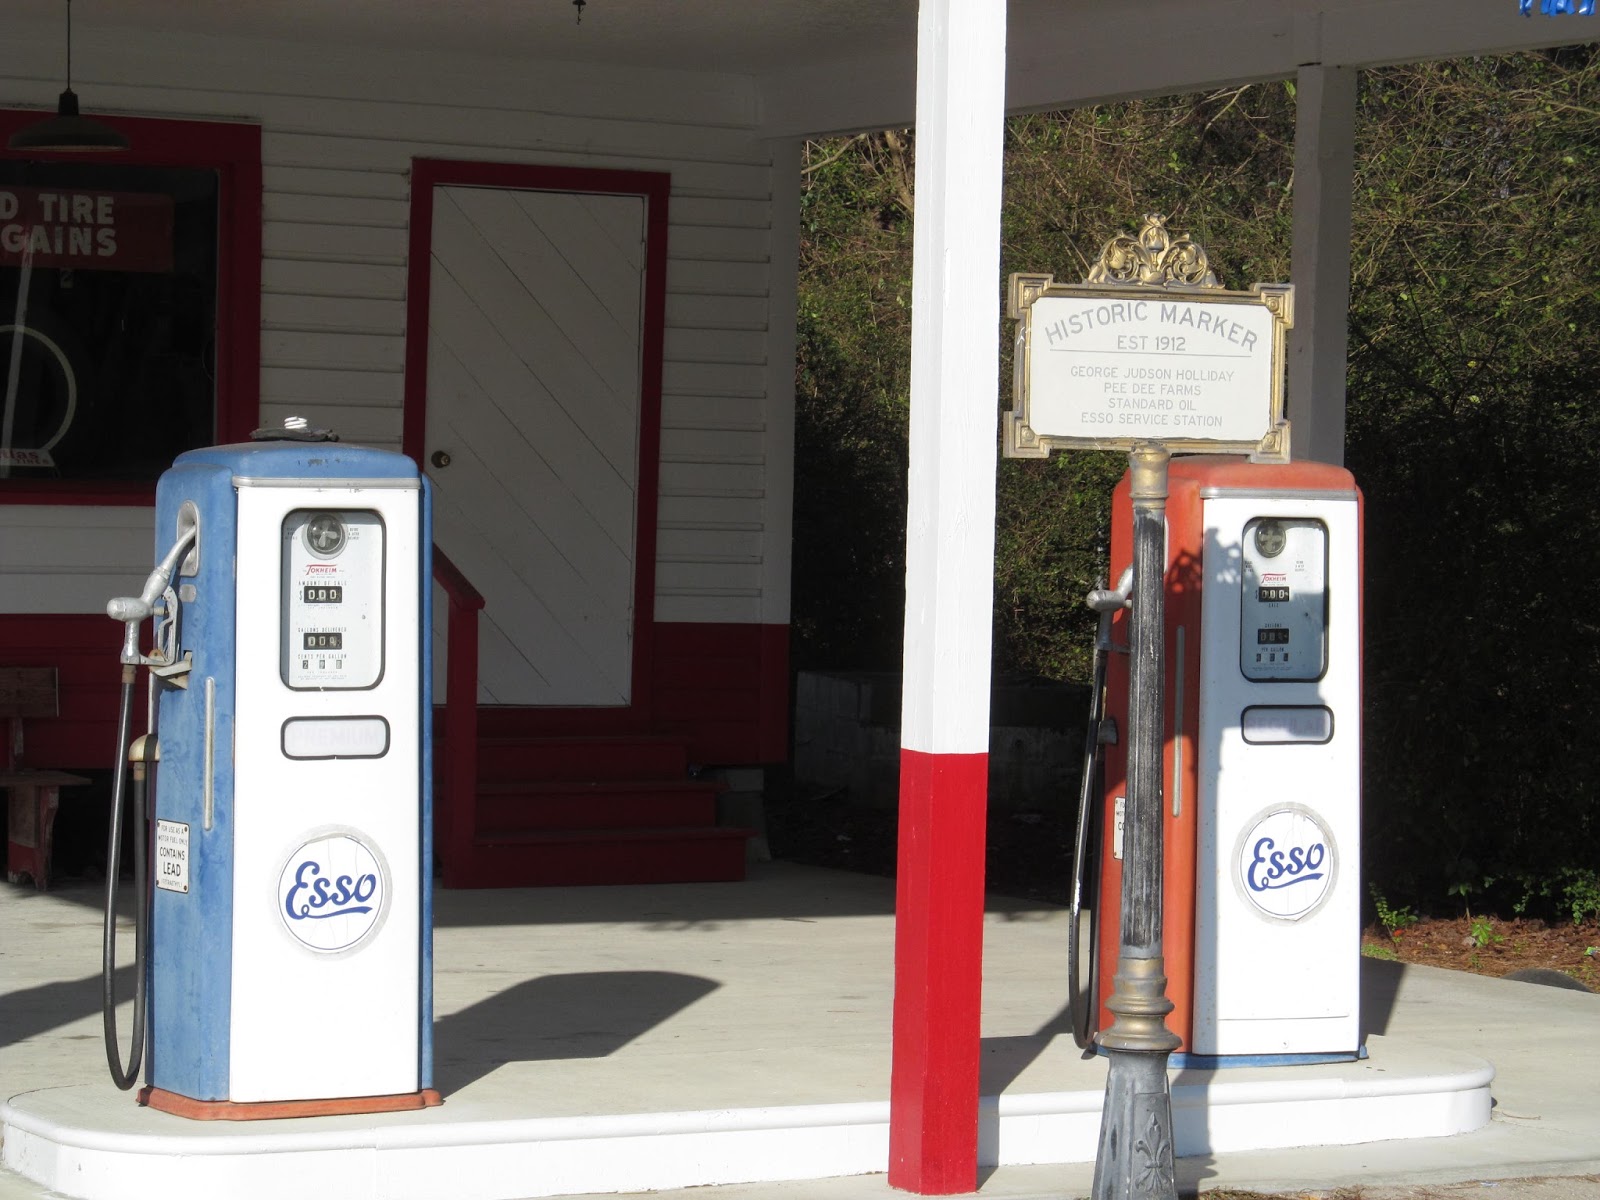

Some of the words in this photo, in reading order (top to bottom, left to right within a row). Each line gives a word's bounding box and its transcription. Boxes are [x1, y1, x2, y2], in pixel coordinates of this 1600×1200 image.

[38, 193, 114, 225] TIRE
[1045, 301, 1148, 345] HISTORIC
[1161, 303, 1258, 352] MARKER
[1117, 335, 1148, 350] EST
[1155, 336, 1186, 351] 1912
[1070, 366, 1119, 378] GEORGE
[1123, 367, 1172, 380] JUDSON
[1176, 369, 1235, 382] HOLLIDAY
[1104, 382, 1127, 394] PEE
[1132, 383, 1156, 395] DEE
[1160, 384, 1202, 396] FARMS
[1108, 398, 1174, 410] STANDARD
[1178, 399, 1197, 411] OIL
[1081, 412, 1114, 424] ESSO
[1118, 413, 1168, 425] SERVICE
[1173, 415, 1223, 427] STATION
[305, 564, 337, 576] TOKHEIM
[291, 726, 379, 746] PREMIUM
[159, 846, 185, 861] CONTAINS
[163, 861, 182, 877] LEAD
